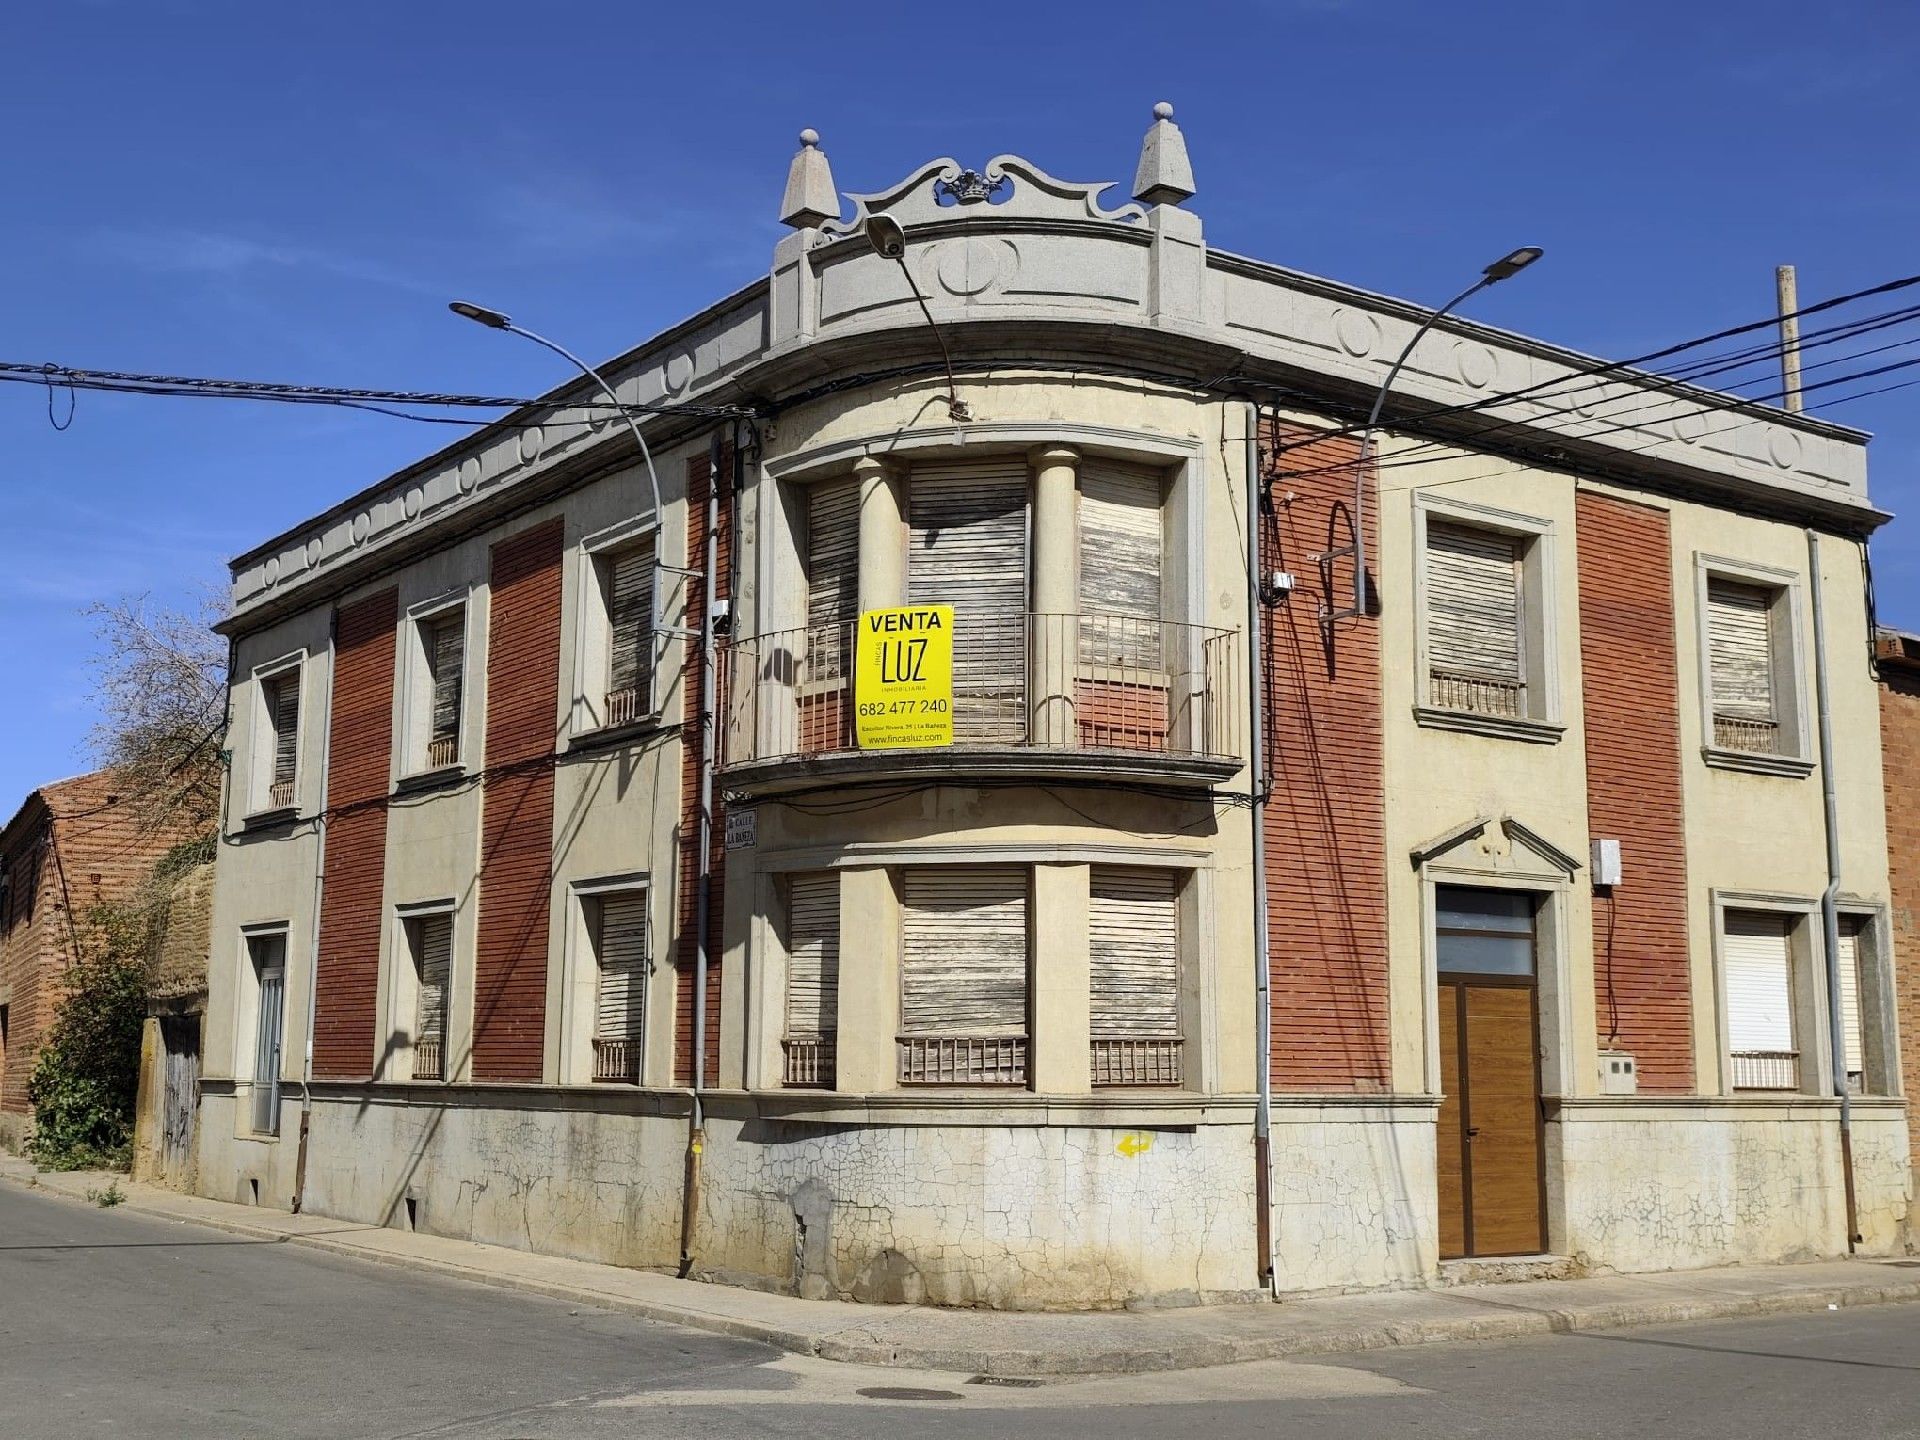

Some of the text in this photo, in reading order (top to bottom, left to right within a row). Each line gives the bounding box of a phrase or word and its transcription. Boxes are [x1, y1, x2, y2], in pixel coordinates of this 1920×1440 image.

[870, 612, 942, 632] VENTA
[874, 641, 882, 666] FINCAS
[882, 639, 928, 683] LUZ
[881, 685, 927, 693] INMOBILIARIA
[859, 699, 947, 716] 682 477 240
[868, 733, 943, 745] www.fincasluz.com
[735, 816, 752, 828] CALLE
[728, 832, 735, 844] LA
